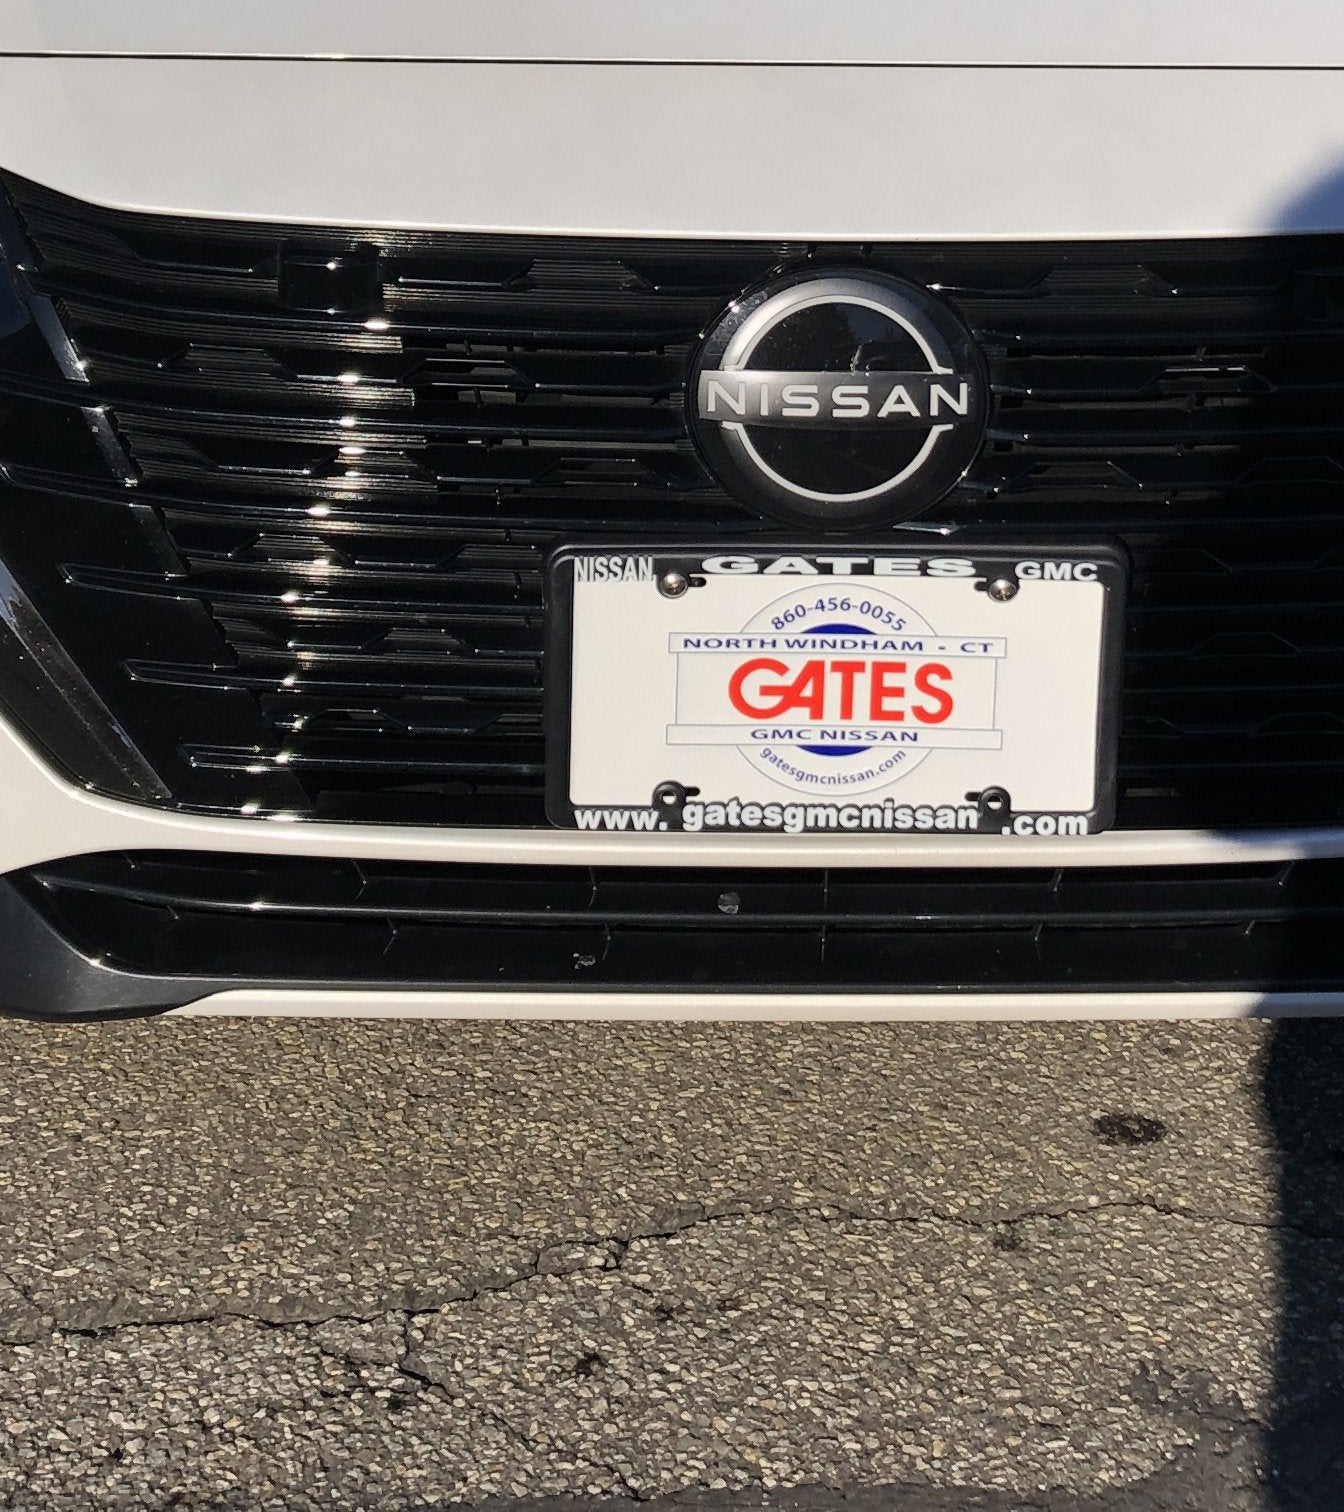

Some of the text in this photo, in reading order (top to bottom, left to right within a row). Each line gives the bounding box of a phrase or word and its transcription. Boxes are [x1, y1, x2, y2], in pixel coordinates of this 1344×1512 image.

[706, 379, 969, 418] NISSAN
[573, 555, 1098, 583] NISSAN GATES GMC
[770, 597, 907, 632] 860-456-0055
[682, 638, 778, 650] NORTH
[784, 639, 924, 651] WINDHAM
[960, 642, 994, 653] CT
[727, 657, 954, 725] GATES
[750, 729, 919, 742] GMC NISSAN
[759, 745, 907, 785] gatesgmcnissan.com
[574, 797, 1089, 836] www. gatesgmcnissan .com
